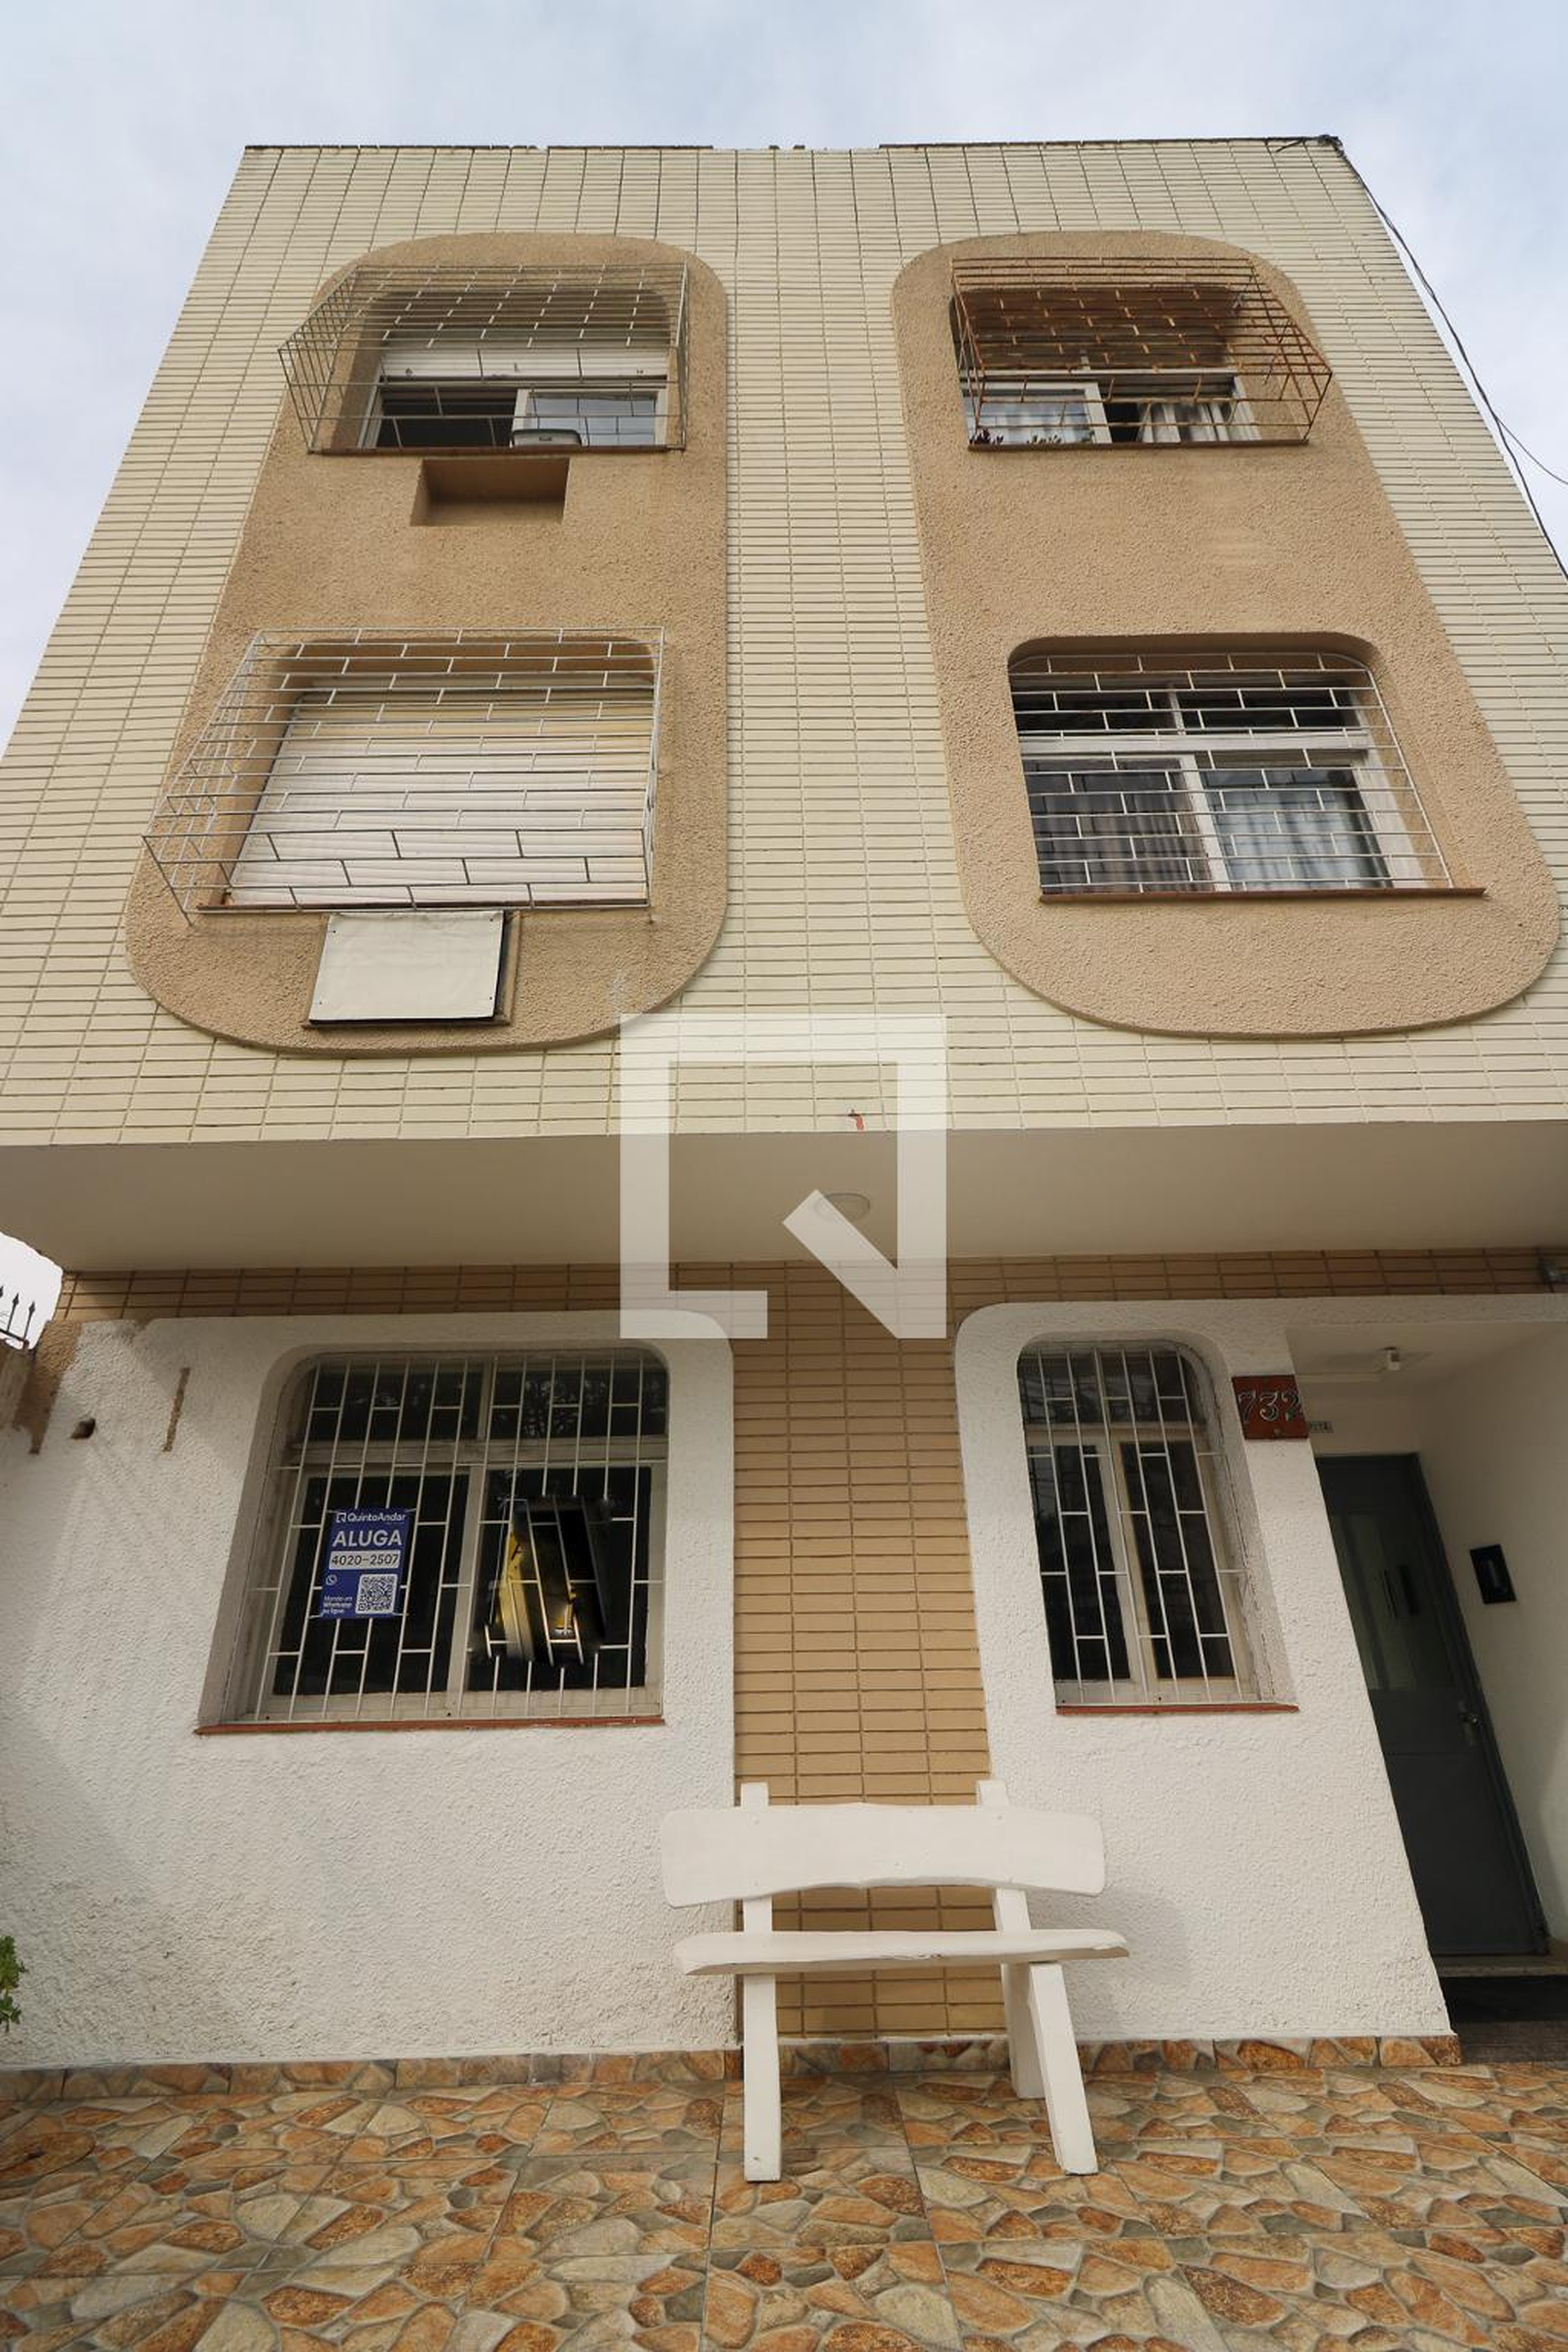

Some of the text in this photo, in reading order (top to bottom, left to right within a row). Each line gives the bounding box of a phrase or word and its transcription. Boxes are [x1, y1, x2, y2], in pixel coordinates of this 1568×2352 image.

[347, 1512, 405, 1522] QuintoAndar
[332, 1530, 402, 1547] ALUGA
[332, 1554, 398, 1565] 4020-2507
